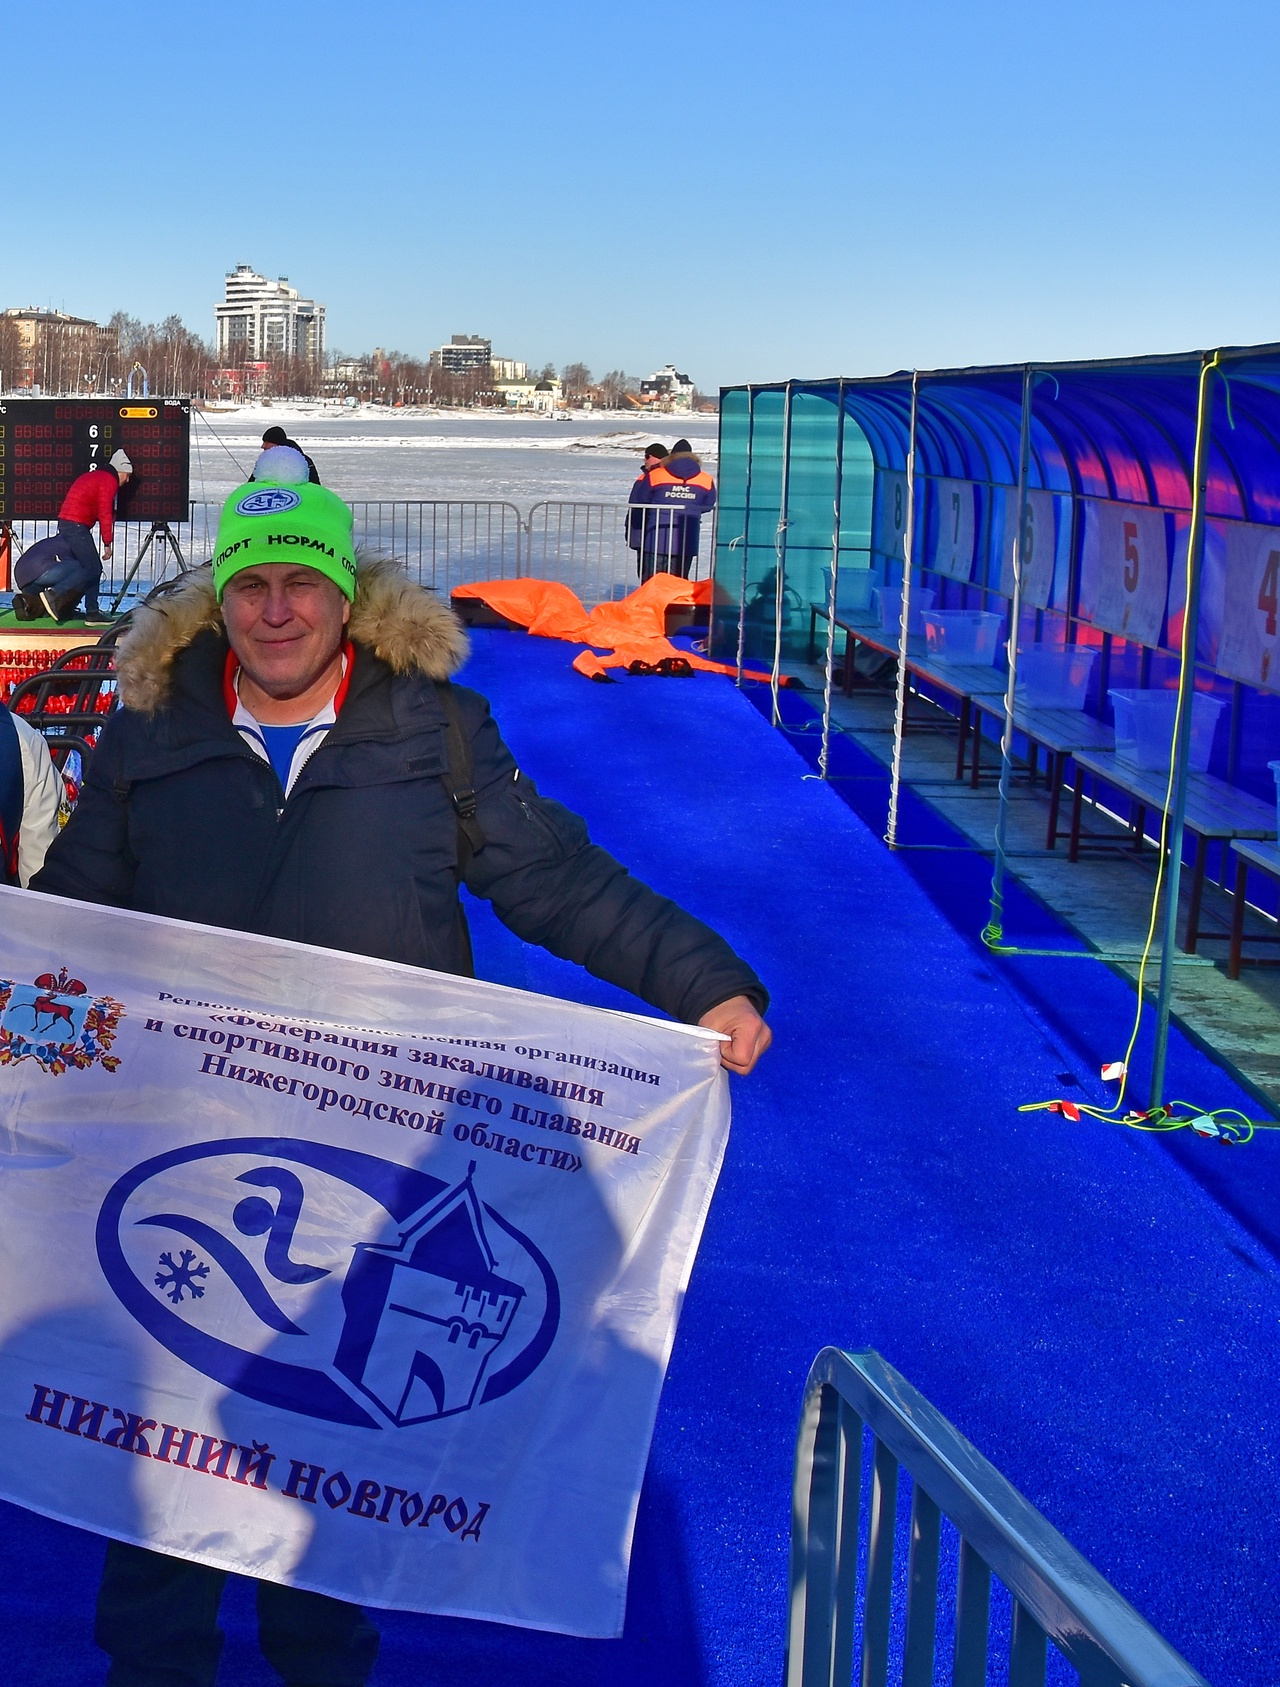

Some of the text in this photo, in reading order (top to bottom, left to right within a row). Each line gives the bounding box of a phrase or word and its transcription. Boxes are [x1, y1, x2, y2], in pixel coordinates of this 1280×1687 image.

[89, 425, 99, 438] 6
[89, 444, 99, 457] 7
[665, 492, 696, 500] РОССИИ
[894, 483, 902, 530] 8
[952, 493, 960, 544] 7
[216, 538, 251, 568] СПОРТ
[268, 534, 335, 558] НОРМА
[1022, 503, 1034, 565] 6
[1123, 522, 1140, 593] 5
[1258, 550, 1280, 636] 4
[143, 1017, 642, 1156] и спортивного зимнего плавания
[209, 1014, 605, 1107] «Федерация закаливания
[514, 1045, 661, 1086] организация
[198, 1052, 584, 1175] Нижегородской области»
[25, 1383, 492, 1543] НИЖНИЙ НОВГОРОД
